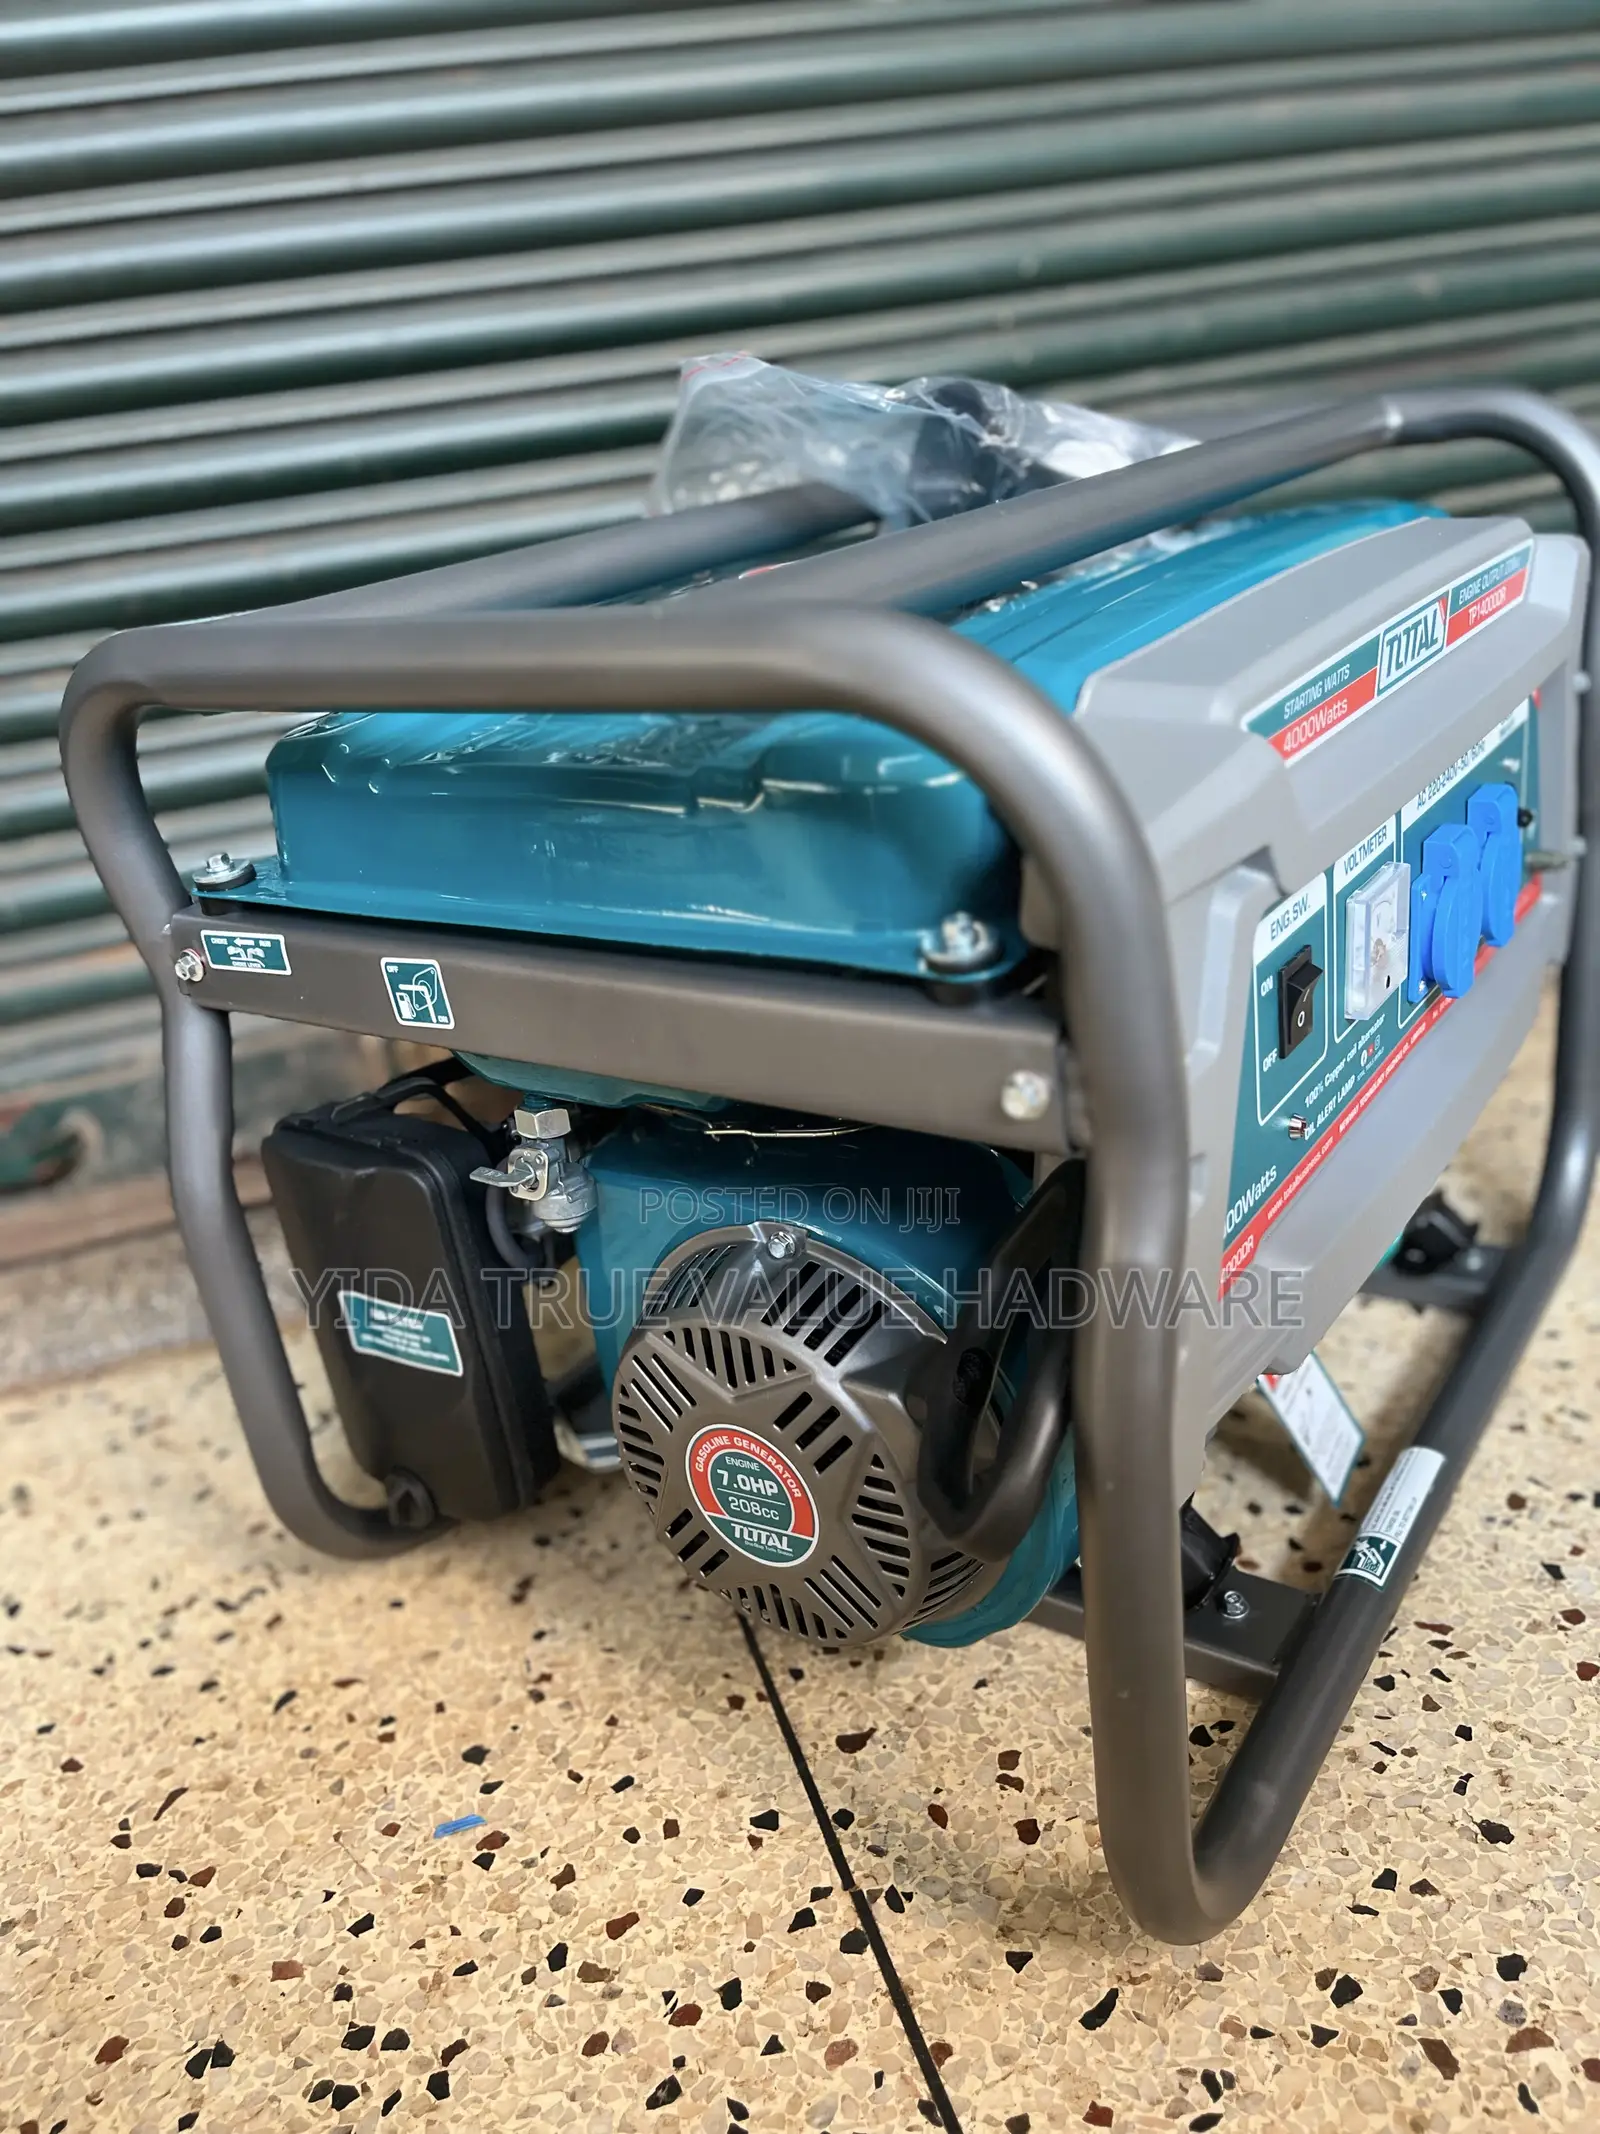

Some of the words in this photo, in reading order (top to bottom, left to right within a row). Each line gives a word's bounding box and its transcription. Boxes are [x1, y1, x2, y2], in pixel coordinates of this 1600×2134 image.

[1459, 577, 1482, 605] ENGINE
[1385, 608, 1439, 678] TOTAL
[1283, 680, 1323, 720] STARTING
[1324, 663, 1351, 693] WATTS
[1283, 698, 1349, 753] 4000Watts
[1344, 824, 1388, 876] VOLTMETER
[386, 965, 399, 974] OFF
[1260, 975, 1274, 997] ON
[437, 1015, 450, 1023] ON
[1262, 1047, 1278, 1072] OFF
[1304, 1080, 1324, 1108] 100%
[1324, 1057, 1347, 1087] Copper
[1316, 1095, 1337, 1128] ALERT
[1337, 1074, 1356, 1104] LAMP
[1222, 1165, 1277, 1238] 00Watts
[695, 1435, 731, 1473] GASOLINE
[733, 1437, 802, 1498] GENERATOR
[725, 1456, 761, 1472] ENGINE
[716, 1469, 779, 1496] 7.0HP
[728, 1496, 780, 1521] 208cc
[731, 1523, 793, 1552] TOTAL
